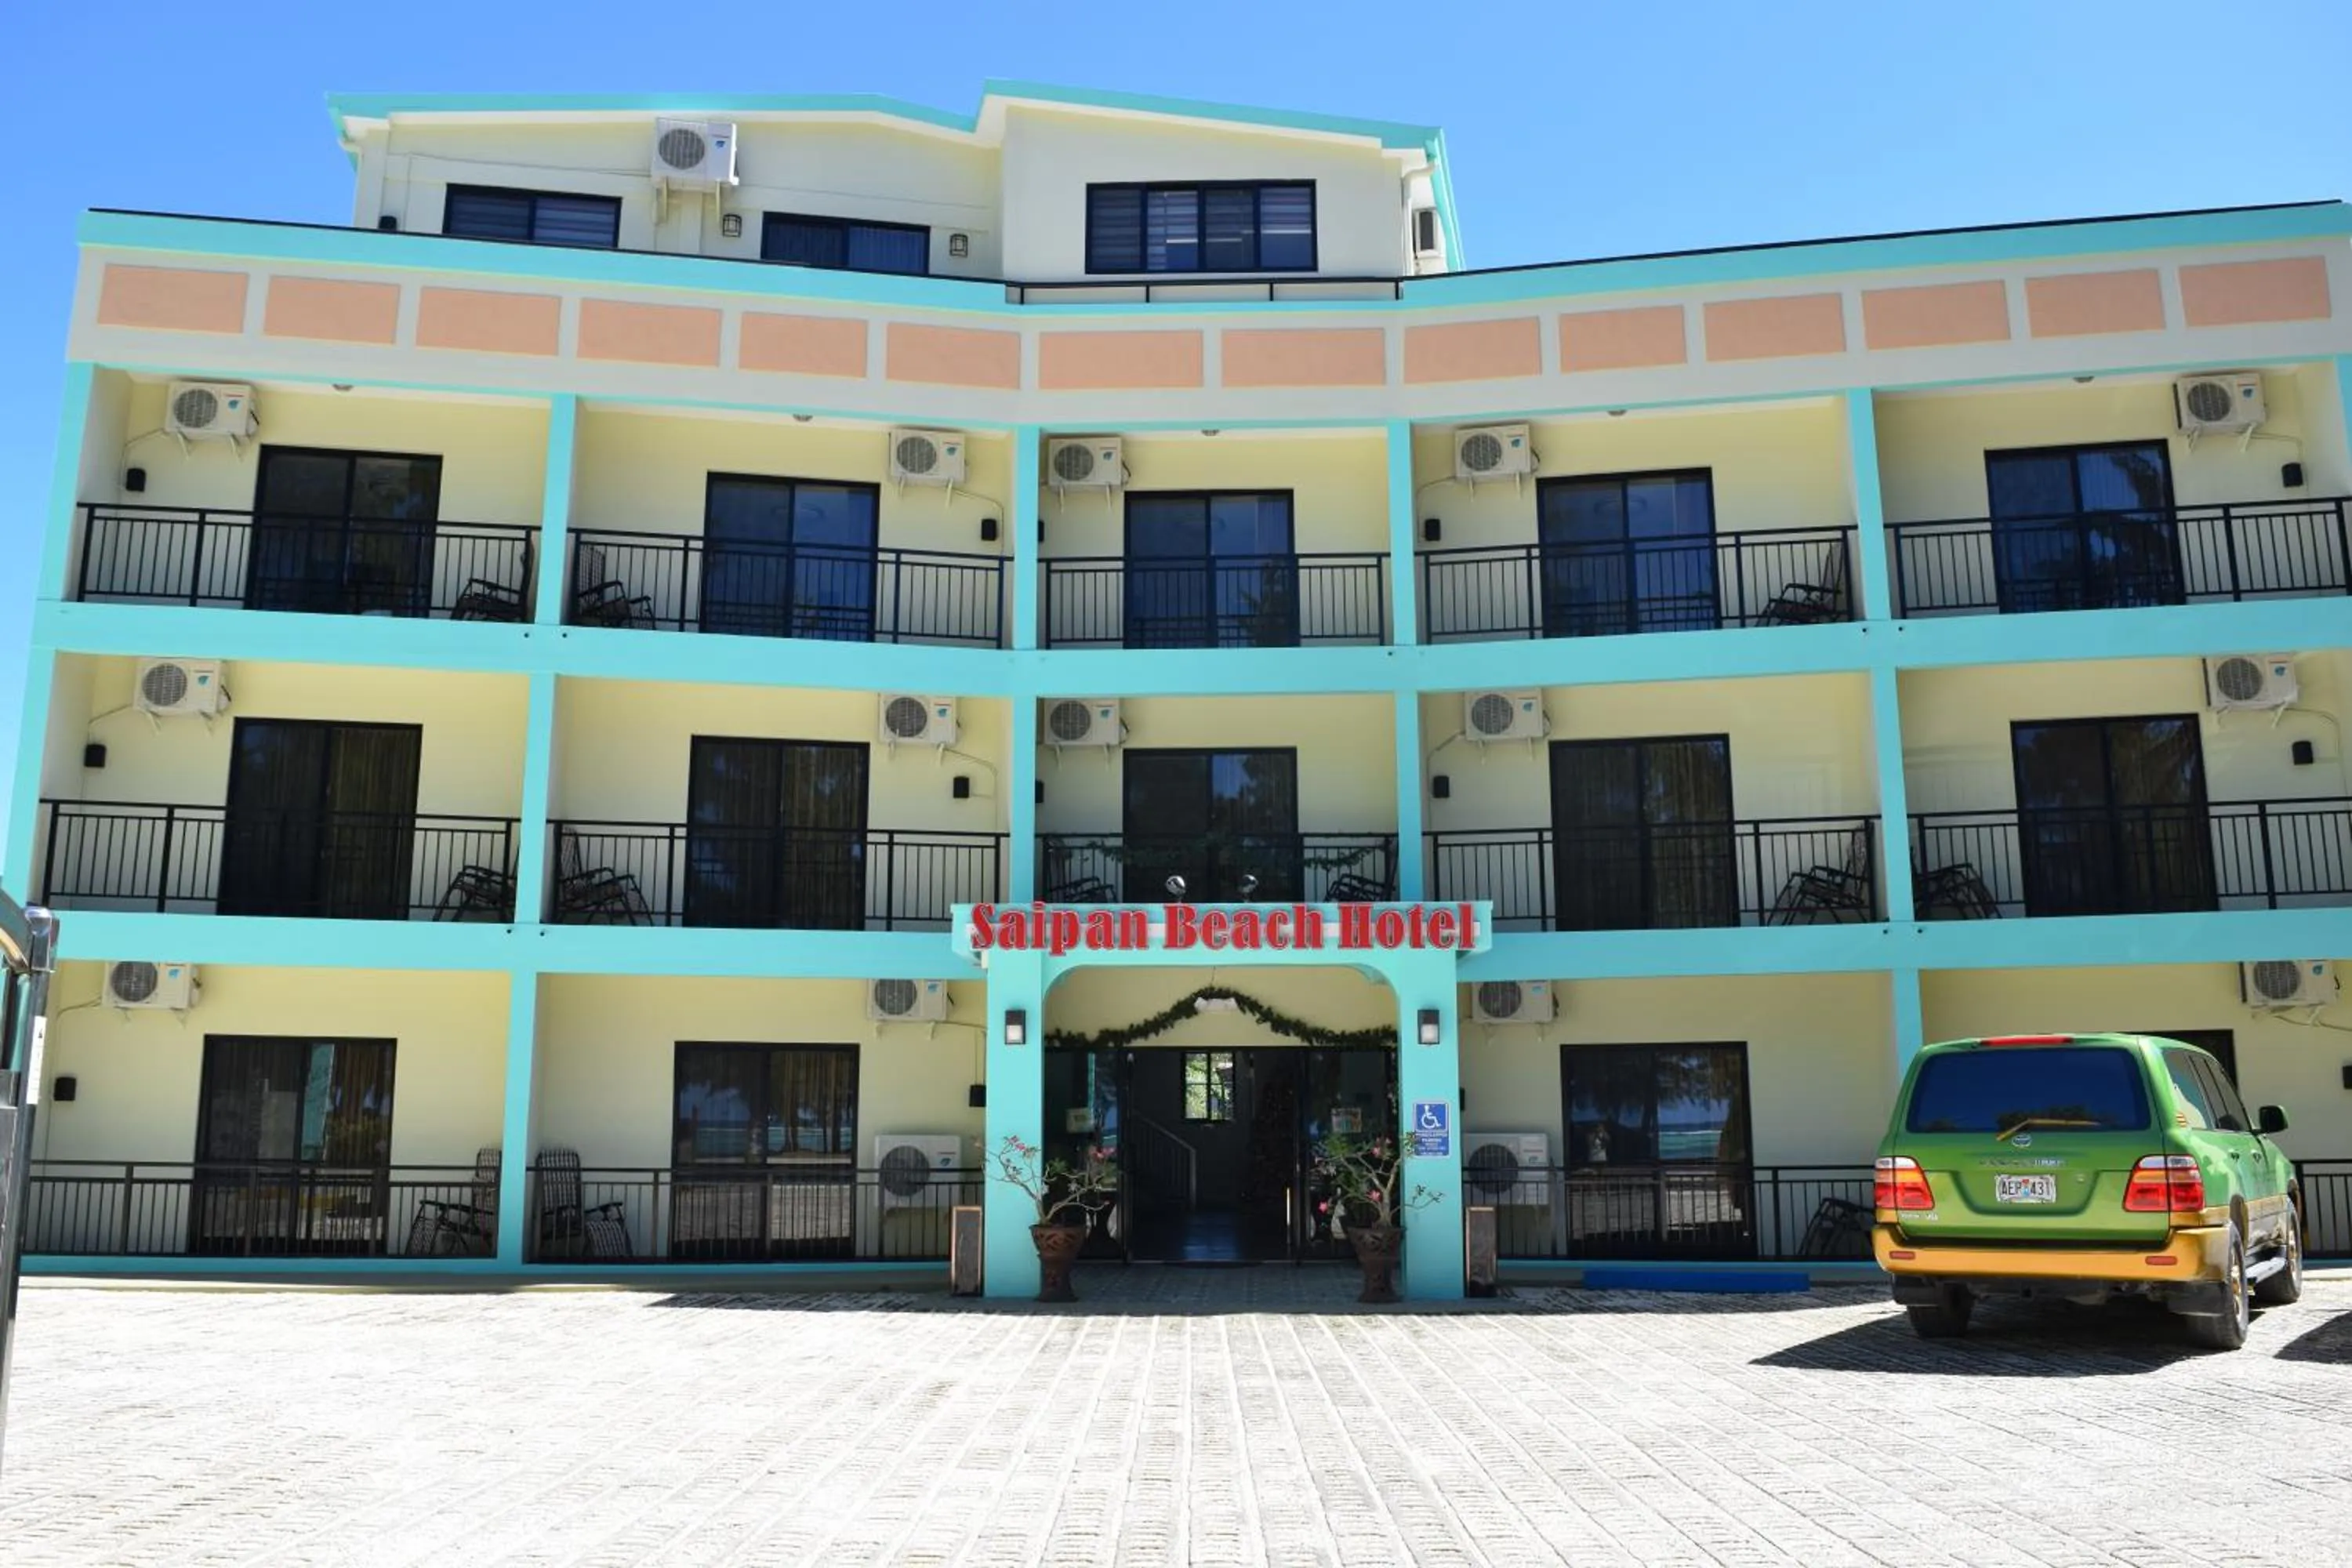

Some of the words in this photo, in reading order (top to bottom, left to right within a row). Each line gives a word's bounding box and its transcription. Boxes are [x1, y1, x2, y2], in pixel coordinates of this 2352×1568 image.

[971, 902, 1149, 956] Saipan
[1163, 902, 1324, 950] Beach
[1338, 902, 1476, 950] Hotel
[2002, 1181, 2022, 1196] AEP
[2030, 1181, 2050, 1196] 431
